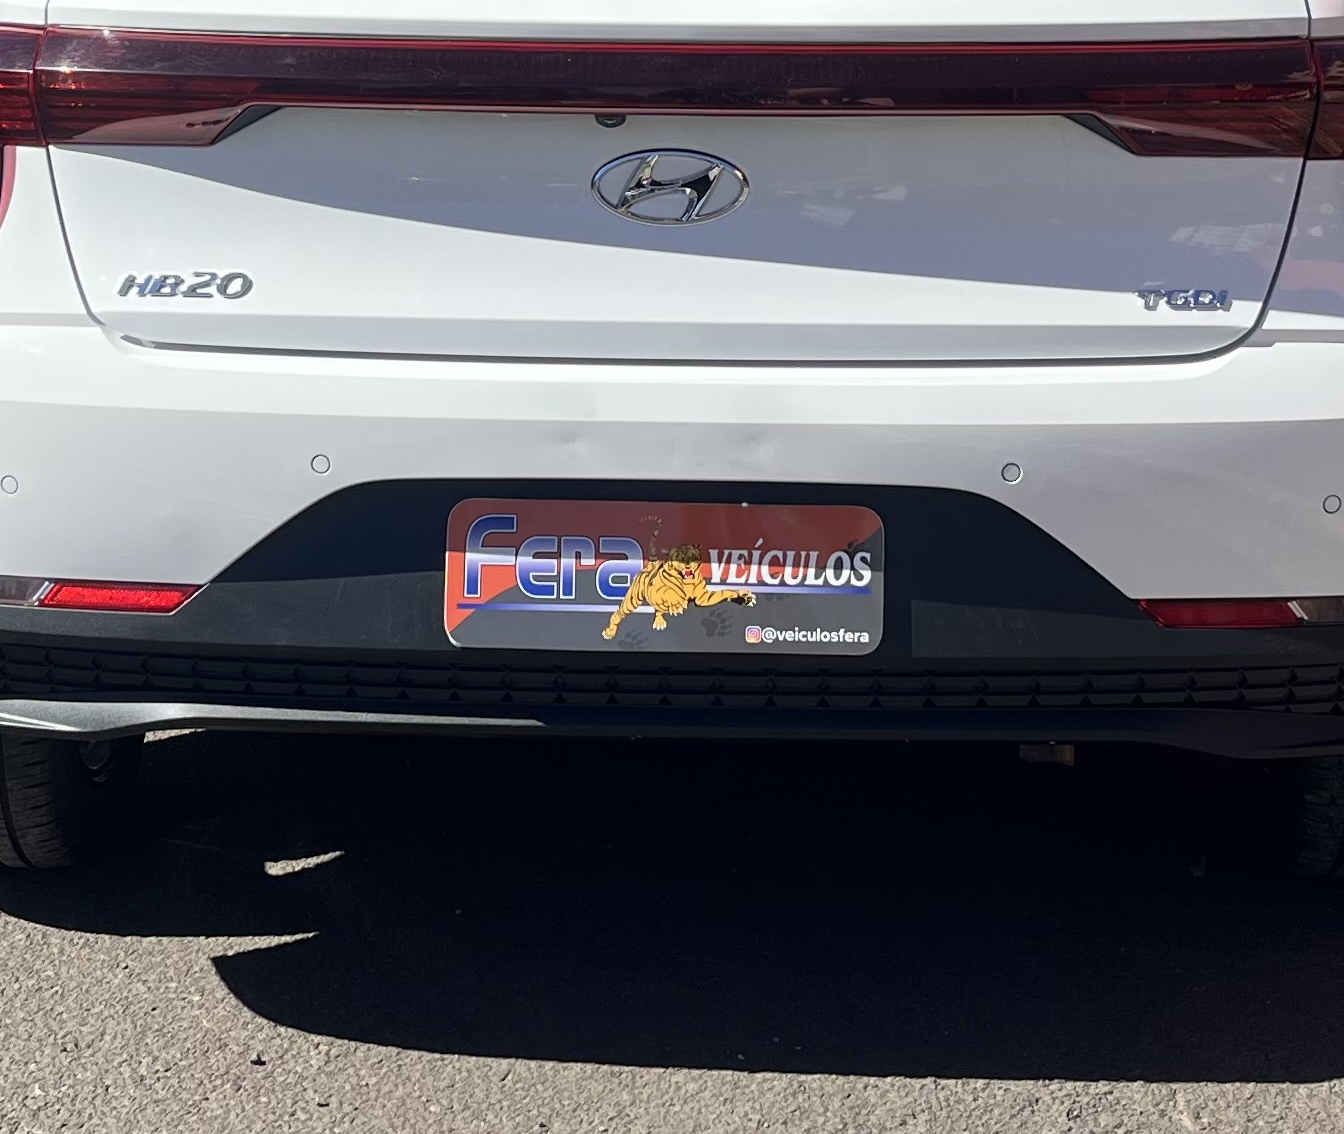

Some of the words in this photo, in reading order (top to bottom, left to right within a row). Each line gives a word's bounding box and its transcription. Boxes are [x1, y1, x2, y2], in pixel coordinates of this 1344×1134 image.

[117, 271, 254, 300] HB20
[464, 513, 644, 600] Fera
[708, 538, 872, 587] VEÍCULOS
[761, 625, 870, 644] @veiculosfera
